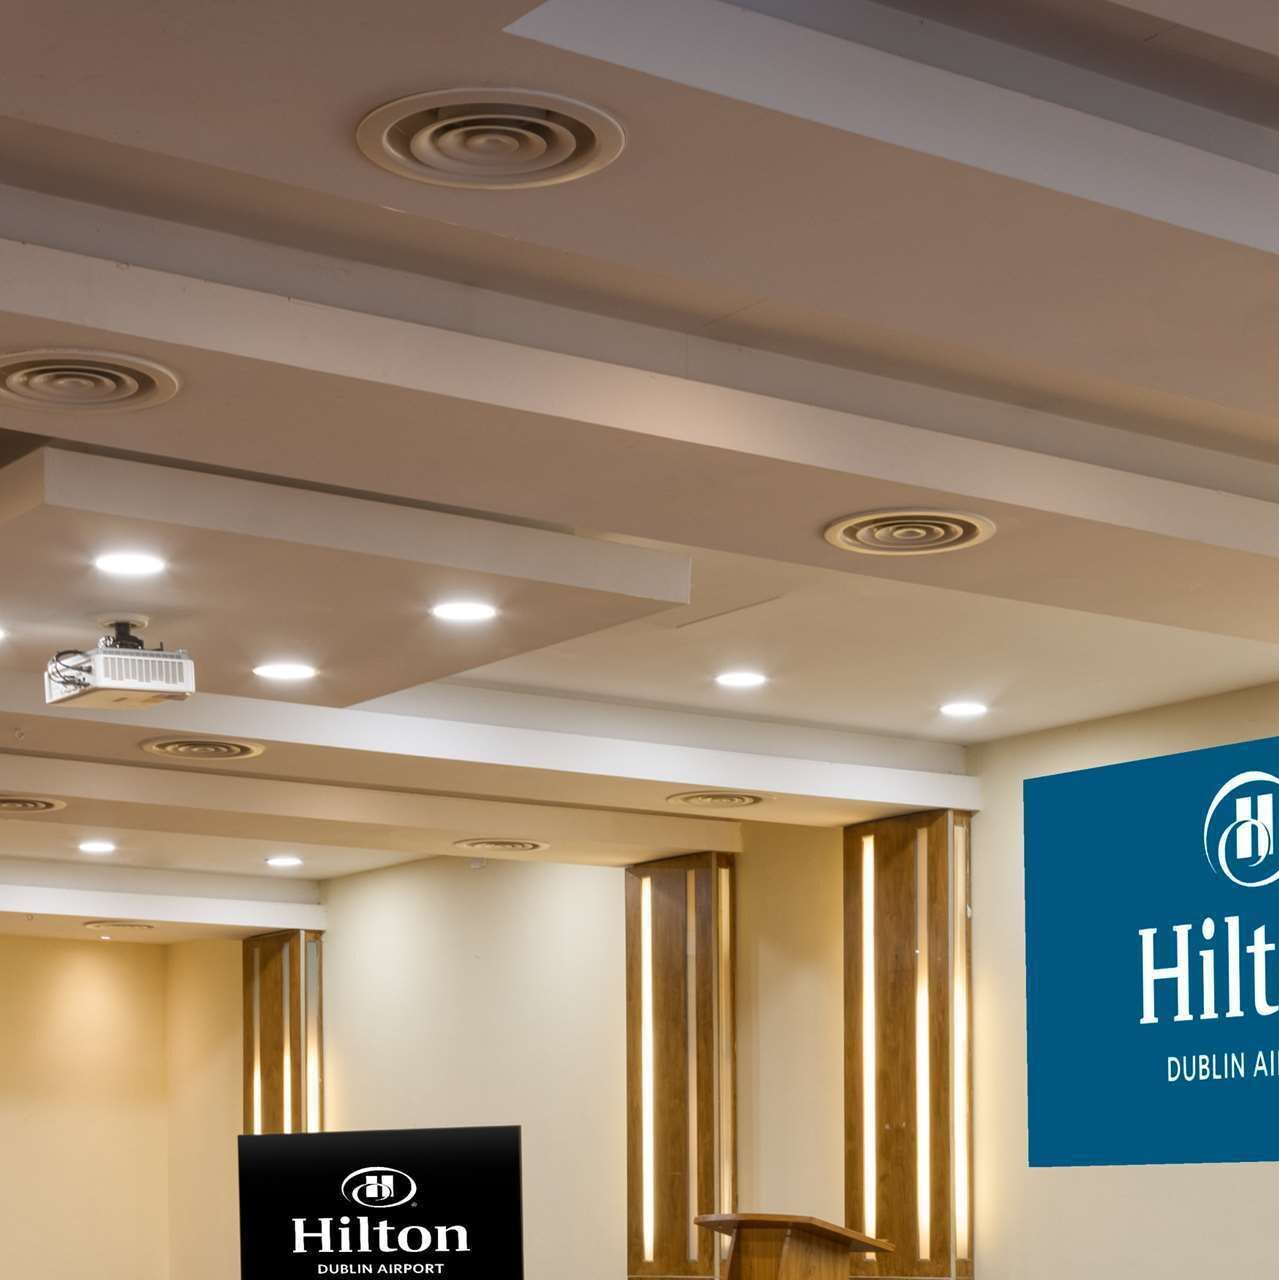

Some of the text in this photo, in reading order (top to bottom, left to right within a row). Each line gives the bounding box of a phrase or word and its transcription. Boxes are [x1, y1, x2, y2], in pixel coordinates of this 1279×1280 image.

[1167, 1051, 1246, 1082] DUBLIN
[291, 1215, 471, 1254] Hilton
[317, 1263, 445, 1275] DUBLIN AIRPORT
